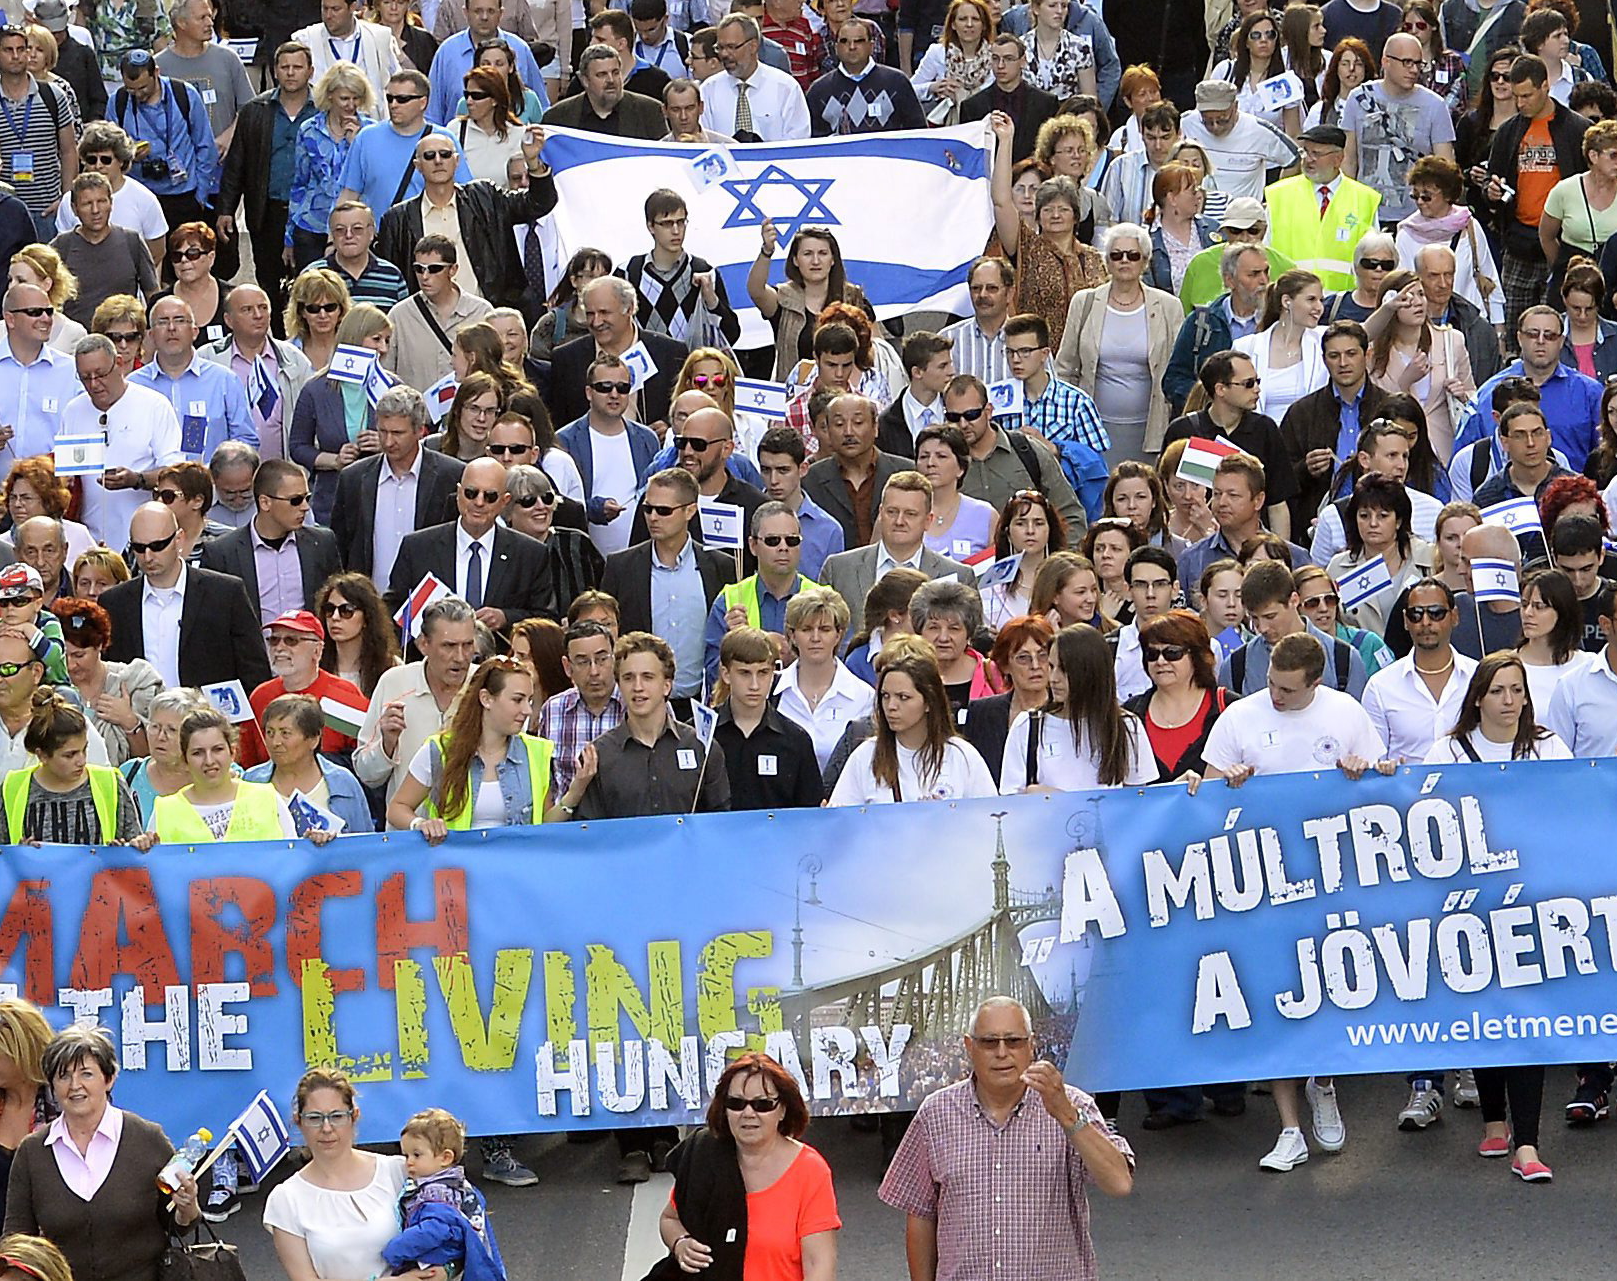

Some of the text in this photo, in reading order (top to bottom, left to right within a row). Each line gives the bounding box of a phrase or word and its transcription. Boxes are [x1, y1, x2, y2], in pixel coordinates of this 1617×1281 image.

[27, 800, 102, 845] WHA
[1141, 771, 1520, 930] MÚLTRÓL
[301, 929, 784, 1084] LIVING
[1191, 951, 1252, 1036] A
